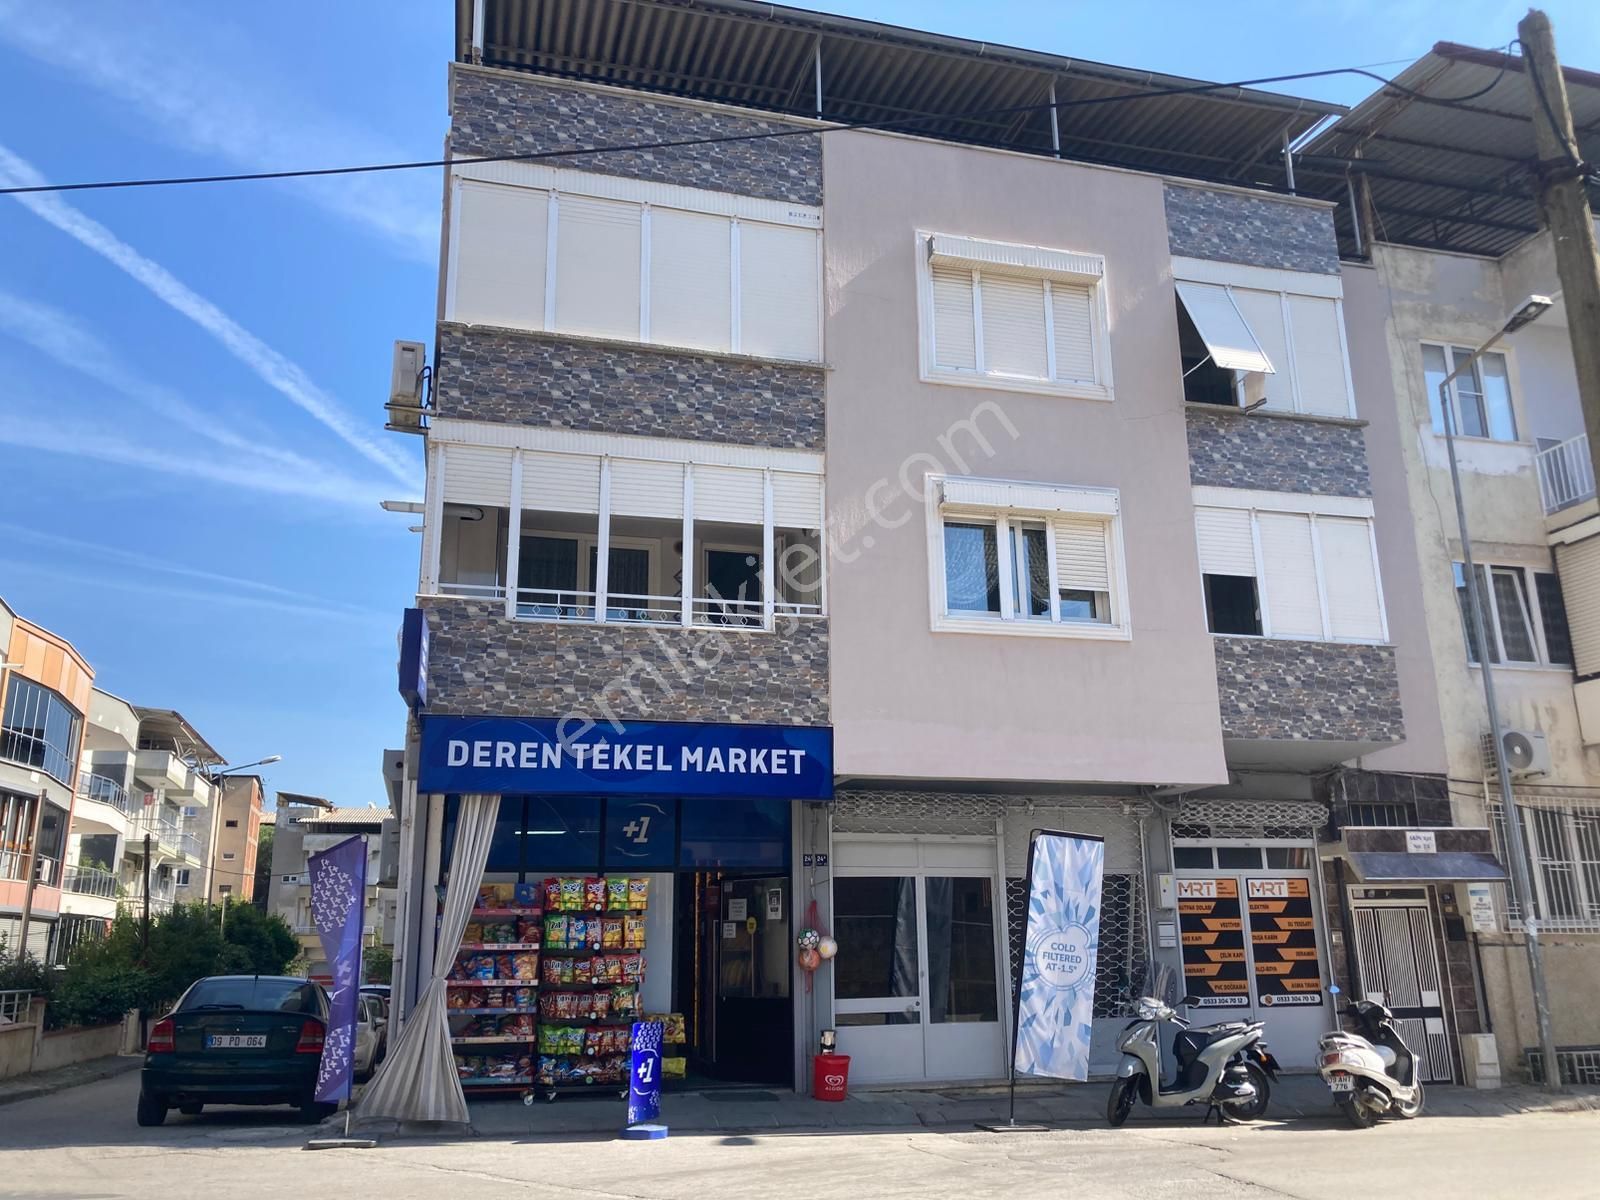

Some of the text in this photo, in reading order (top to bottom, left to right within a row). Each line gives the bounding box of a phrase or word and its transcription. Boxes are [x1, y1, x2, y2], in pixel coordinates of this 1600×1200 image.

[446, 738, 807, 776] DEREN TEKEL MARKET
[622, 815, 652, 844] +1
[1178, 881, 1214, 896] MRT
[1250, 880, 1286, 896] MRT
[1050, 942, 1076, 953] COLD
[1042, 951, 1082, 964] FILTERED
[1045, 962, 1057, 971] AT
[637, 1057, 655, 1083] +1
